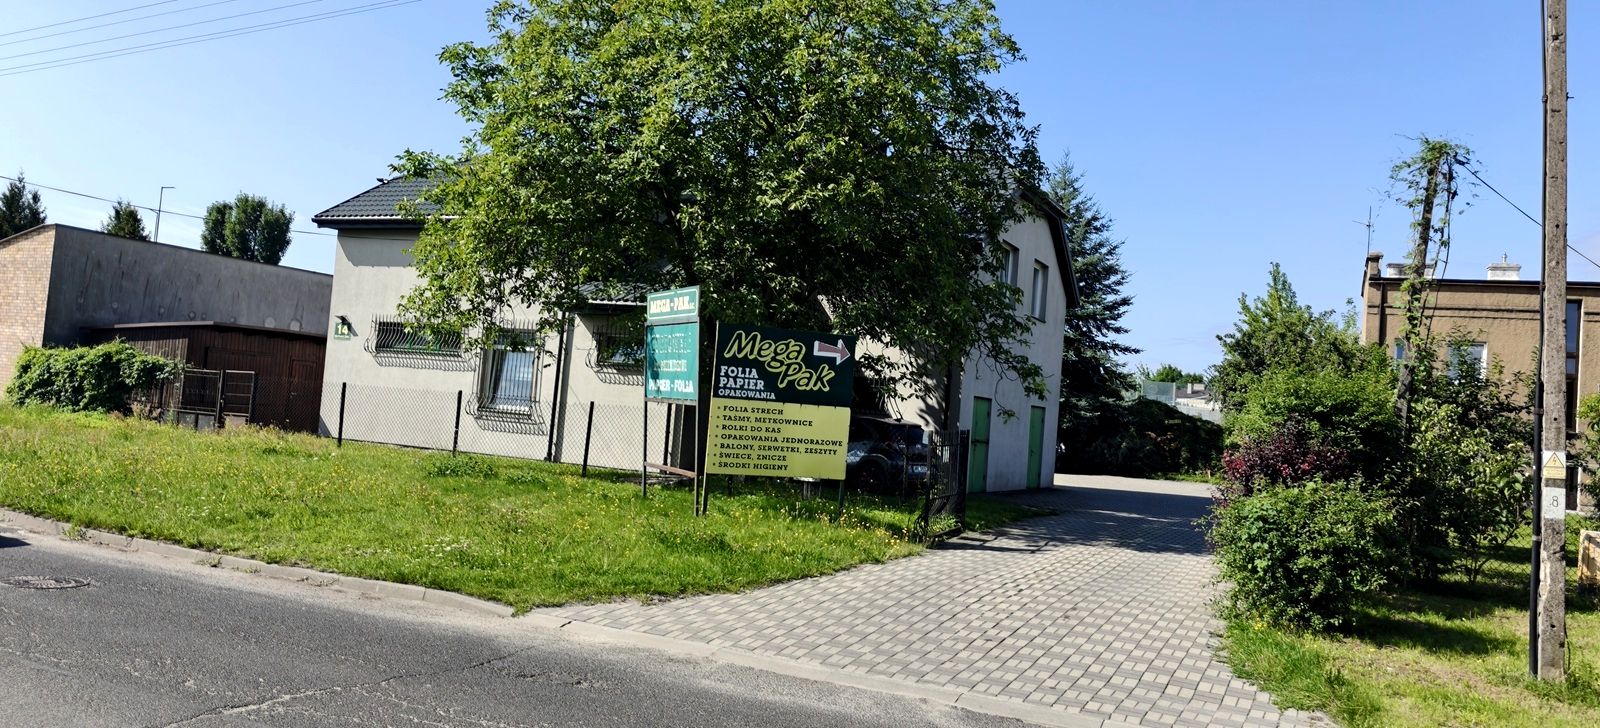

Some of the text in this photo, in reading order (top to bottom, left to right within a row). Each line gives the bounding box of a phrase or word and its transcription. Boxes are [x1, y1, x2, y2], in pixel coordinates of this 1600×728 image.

[337, 324, 349, 335] 14
[723, 330, 806, 373] Mega
[720, 365, 759, 378] FOLIA
[777, 360, 836, 392] Pak
[719, 376, 765, 390] PAPIER
[718, 388, 776, 400] OPAKOWANIA
[723, 405, 784, 415] FOLIA STRECH
[722, 414, 813, 427] TAŚMY, METKOWNICE
[721, 424, 748, 432] ROLKI
[765, 426, 782, 434] KAS
[720, 433, 843, 446] OPAKOWANIA JEDNORAZOWE
[720, 443, 838, 456] BALONY, SERWETKI, ZESZYTY
[756, 454, 787, 462] ZNICZE
[718, 461, 789, 471] ŚRODKI HIGIENY
[1551, 495, 1559, 508] 8
